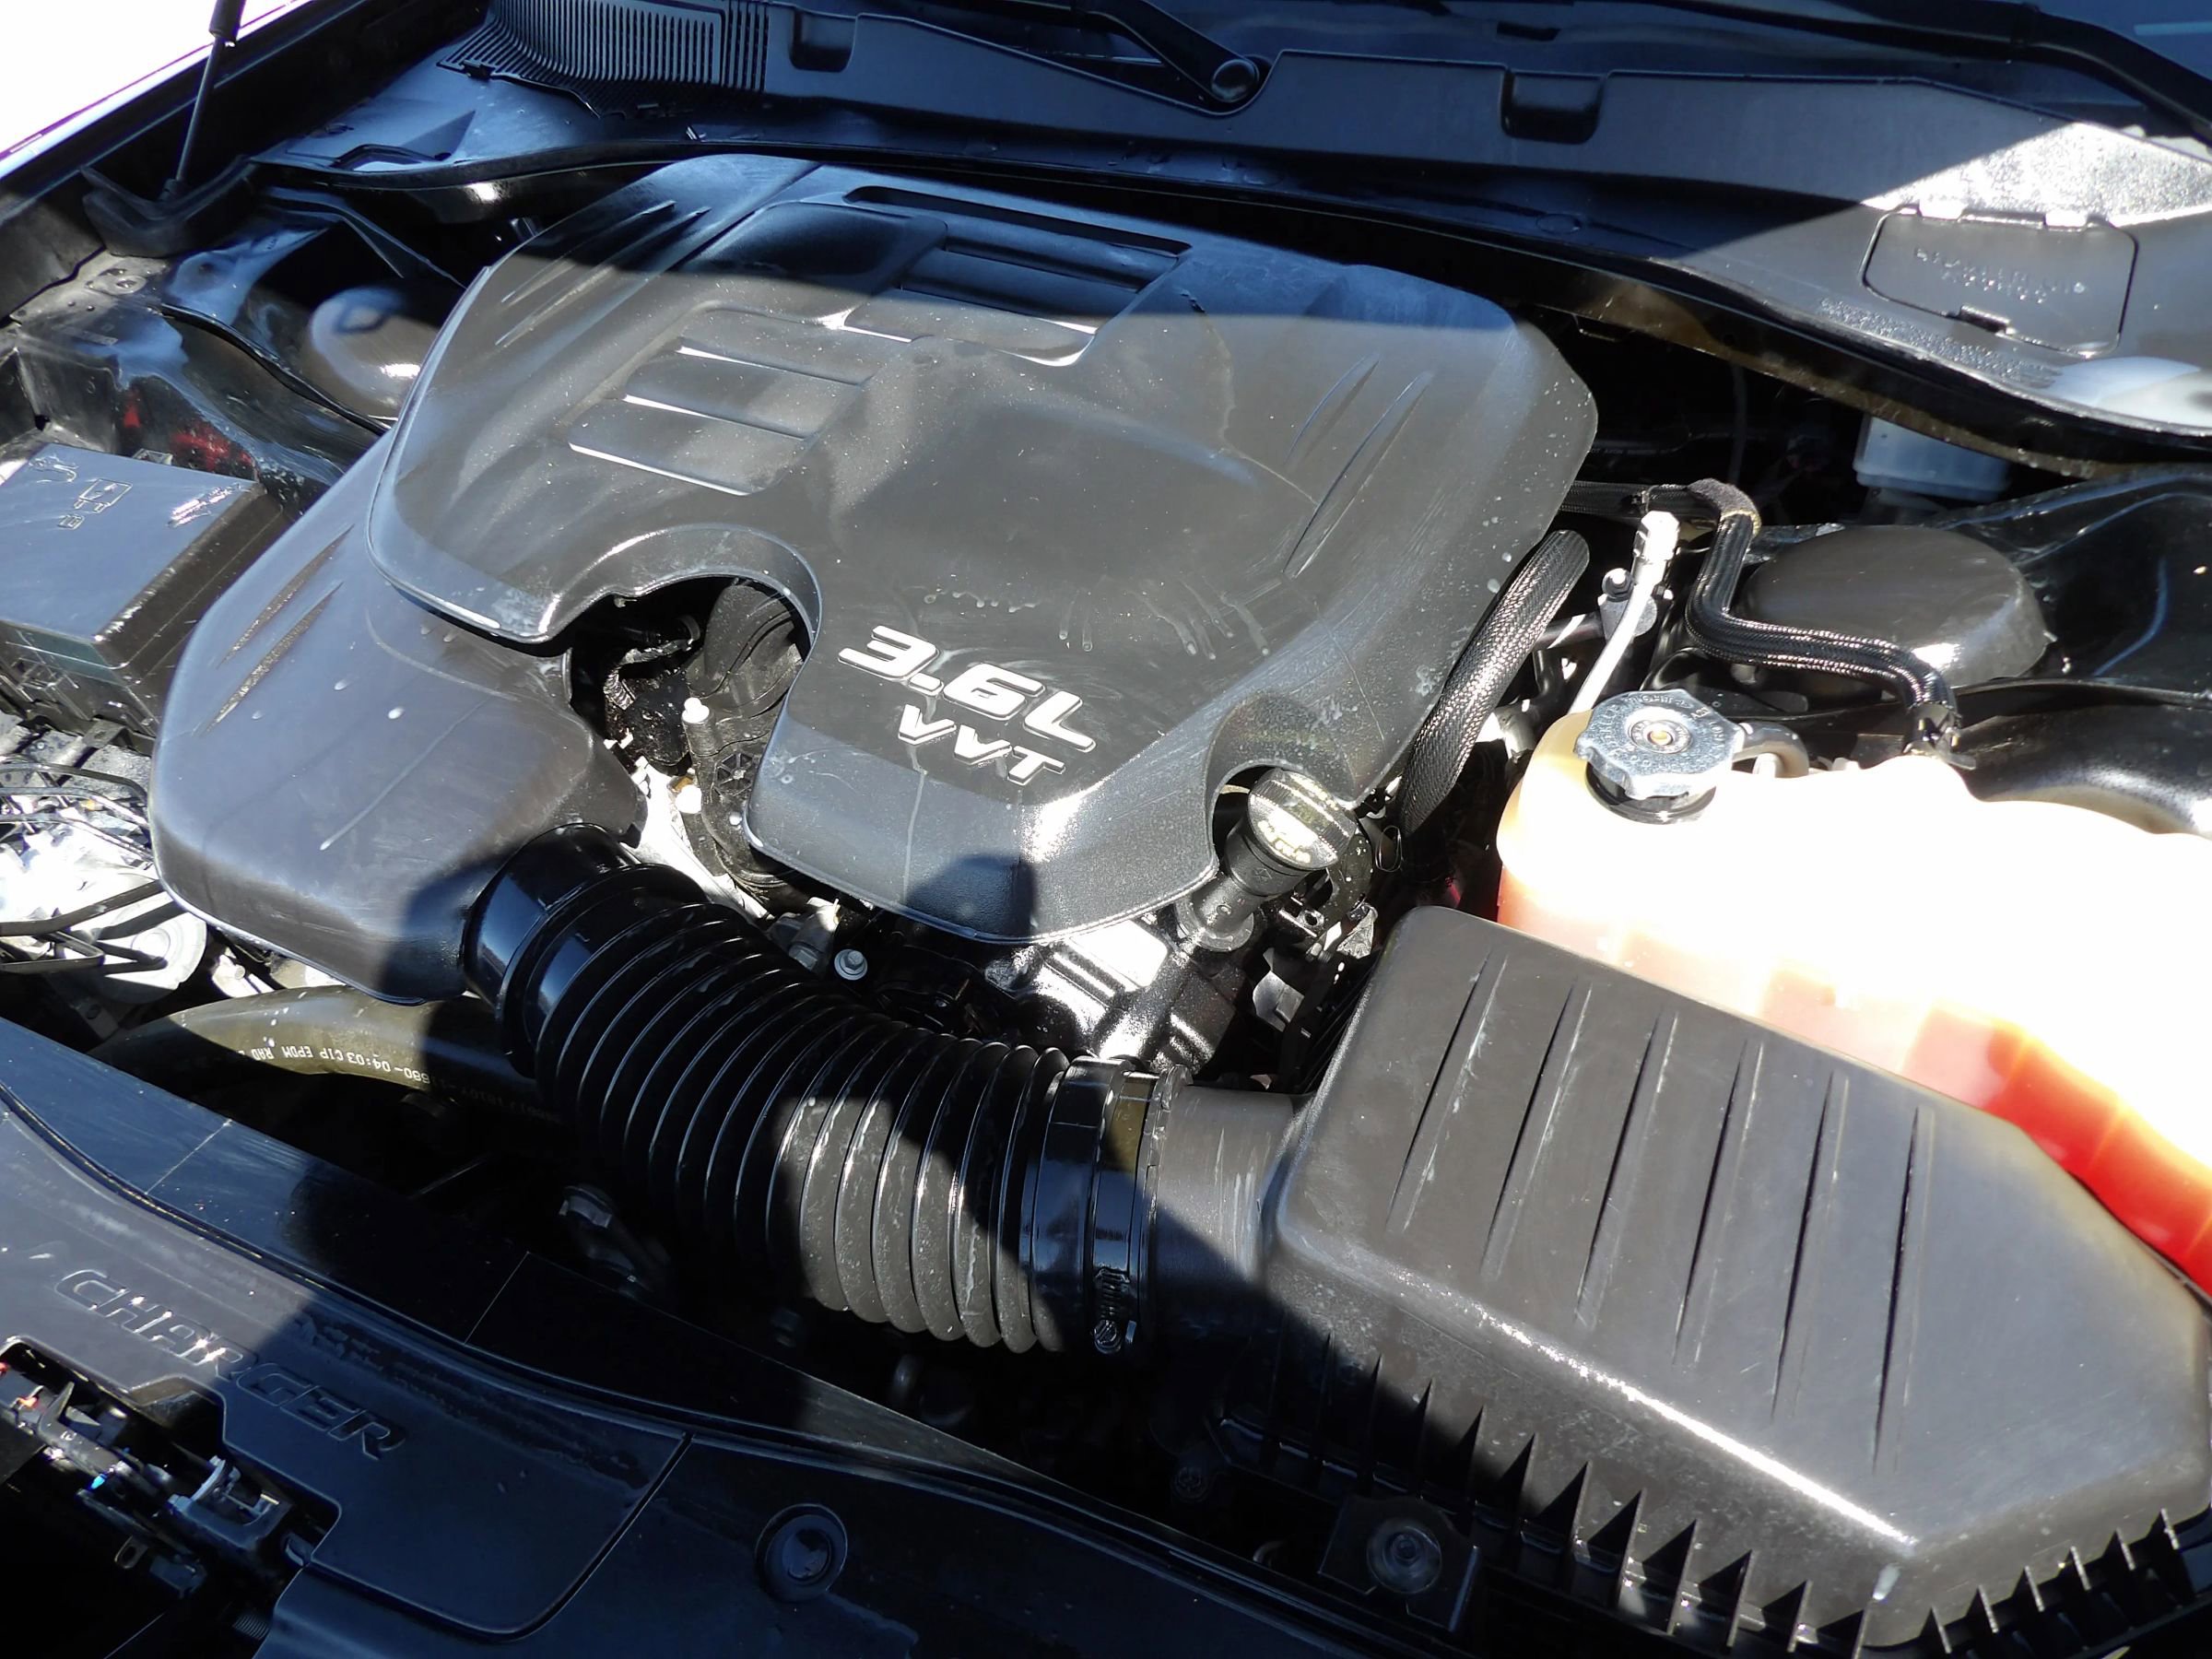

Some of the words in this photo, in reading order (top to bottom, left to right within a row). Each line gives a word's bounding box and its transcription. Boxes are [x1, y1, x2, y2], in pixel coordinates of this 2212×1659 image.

[838, 625, 1096, 753] 3.6L
[898, 703, 1066, 785] VVT
[251, 1046, 274, 1061] RAD
[281, 1045, 313, 1059] EPDM
[54, 1268, 407, 1462] CHARGER
